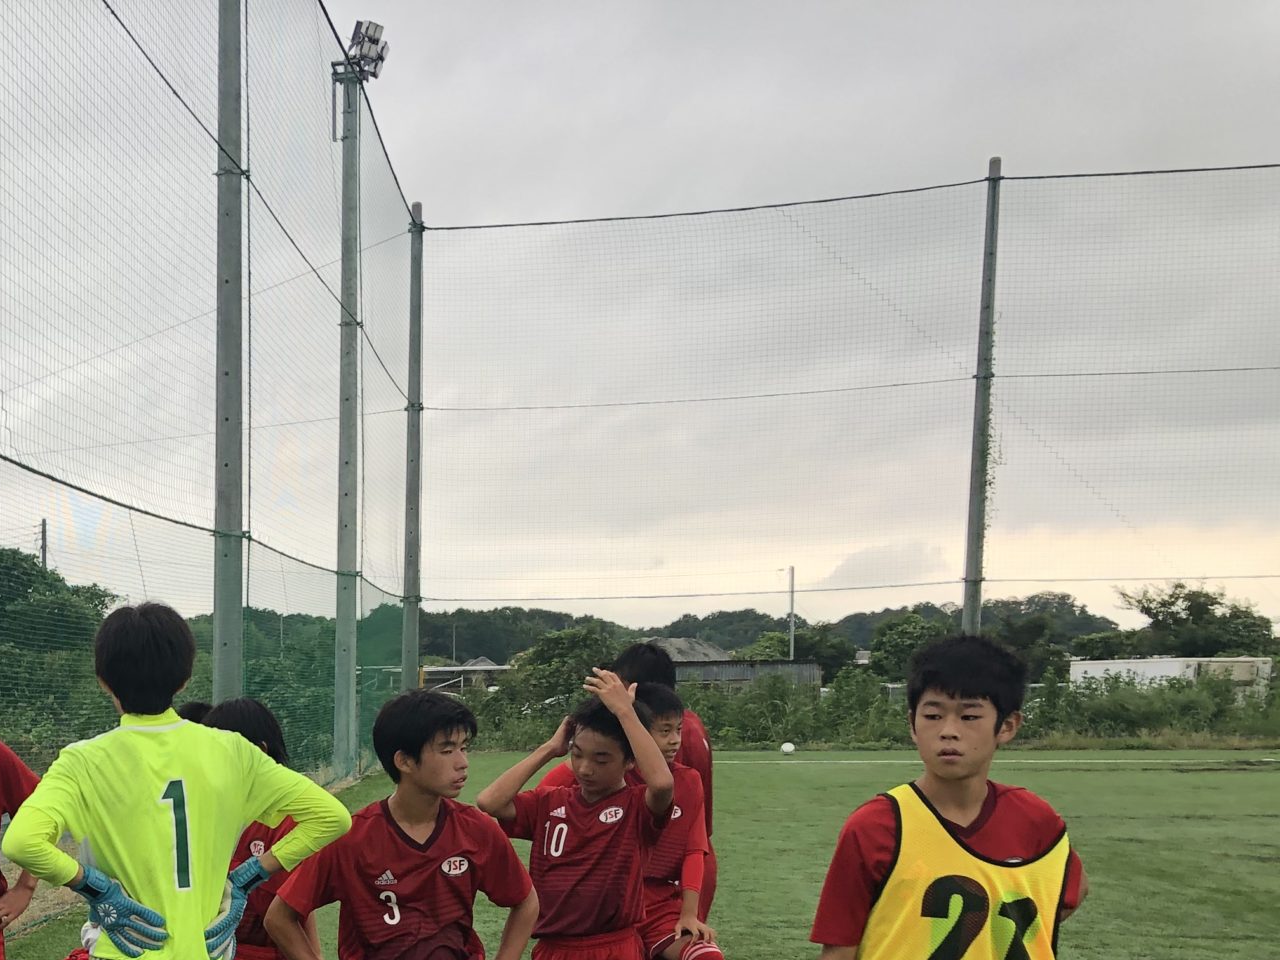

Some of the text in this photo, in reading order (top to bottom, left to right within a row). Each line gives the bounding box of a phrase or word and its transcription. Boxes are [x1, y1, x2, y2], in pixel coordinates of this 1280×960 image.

[604, 809, 621, 821] JSF
[160, 778, 191, 889] 1
[544, 820, 568, 857] 10
[446, 860, 465, 873] JSF
[379, 890, 401, 925] 3
